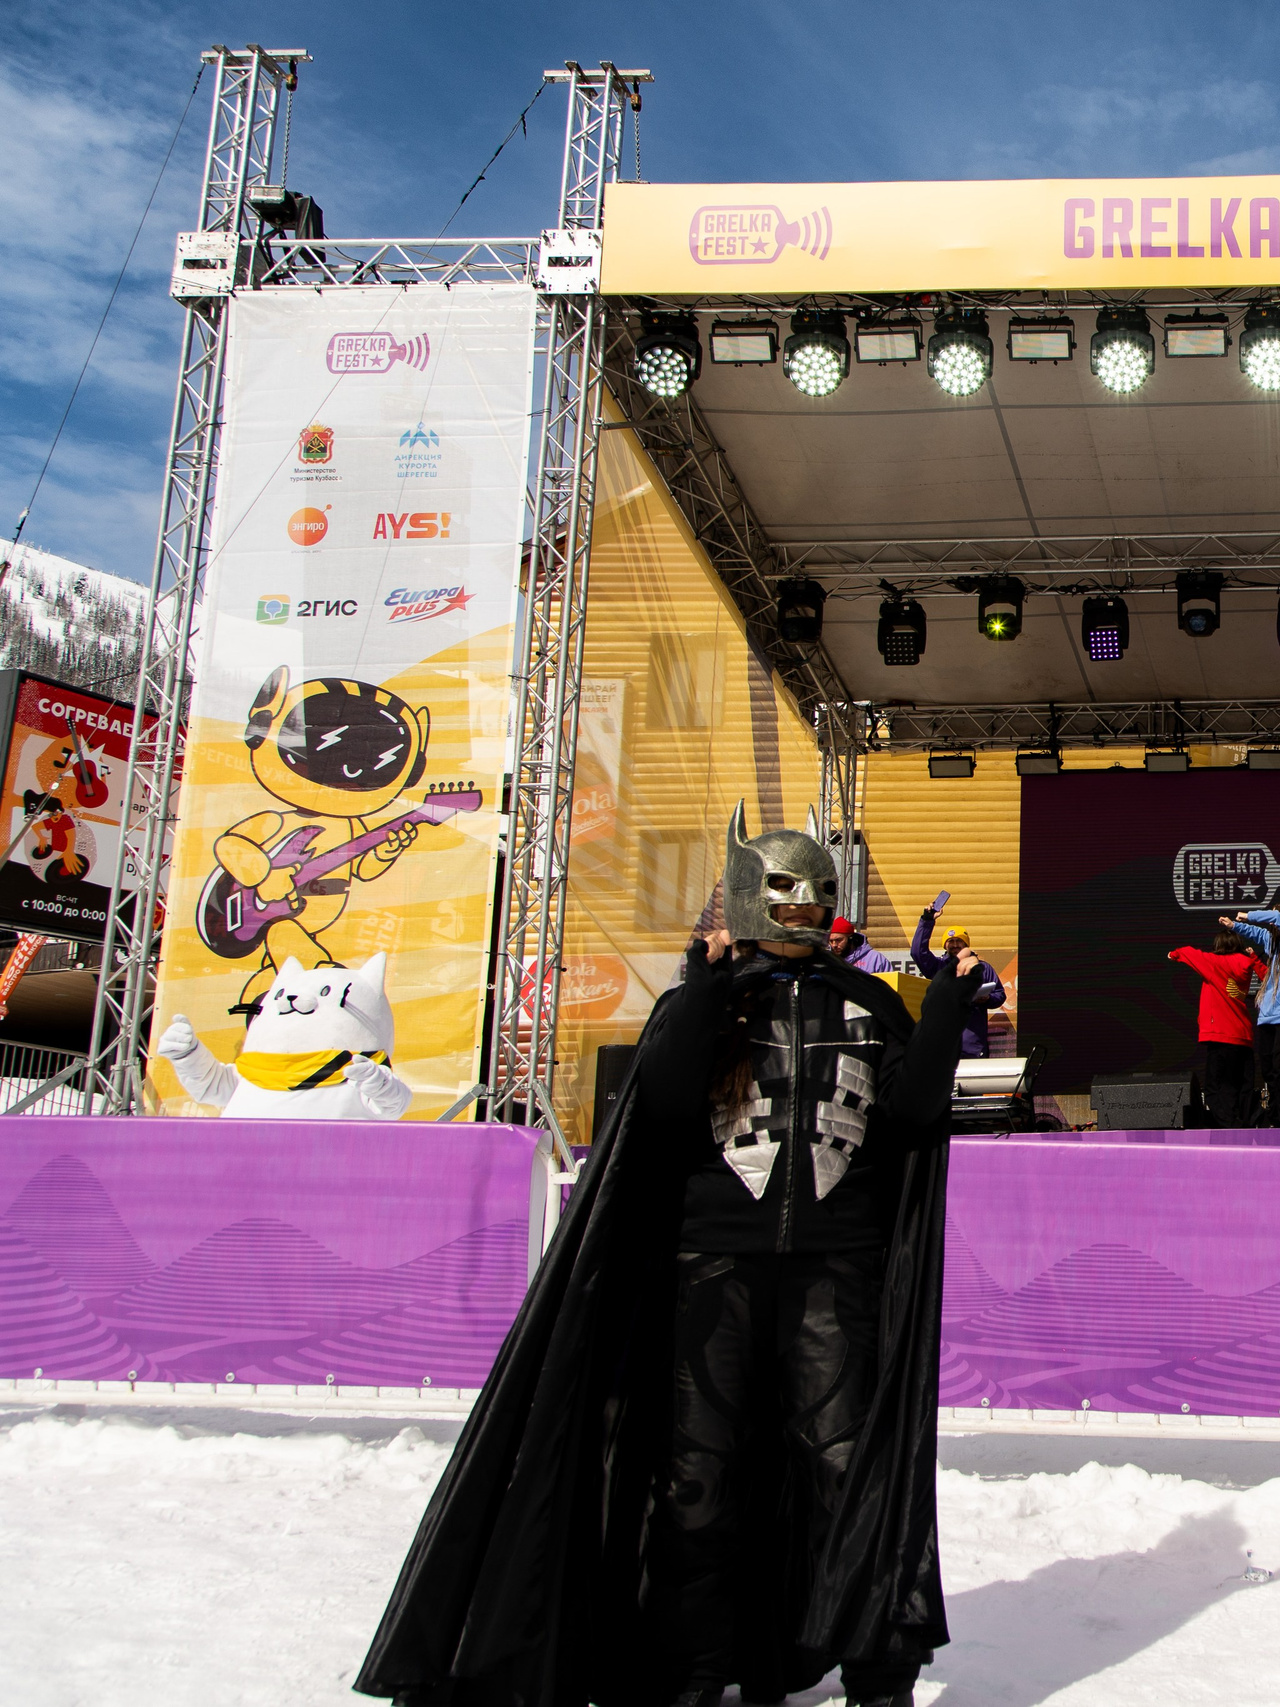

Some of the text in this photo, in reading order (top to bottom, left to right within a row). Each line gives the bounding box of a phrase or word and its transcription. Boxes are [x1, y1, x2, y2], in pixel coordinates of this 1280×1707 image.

[704, 213, 772, 233] GRELKA
[703, 236, 749, 256] FEST
[337, 338, 386, 352] GRELKA
[335, 353, 370, 368] FEST
[291, 522, 325, 533] энгиро
[373, 511, 452, 540] AYS!
[297, 599, 358, 617] 2ГИС
[38, 698, 149, 743] СОГРЕВАЕ
[1189, 852, 1261, 875] GRELKA
[1190, 878, 1238, 900] FEST
[31, 899, 63, 914] 10:00
[63, 907, 79, 918] до
[81, 908, 106, 922] 0:00
